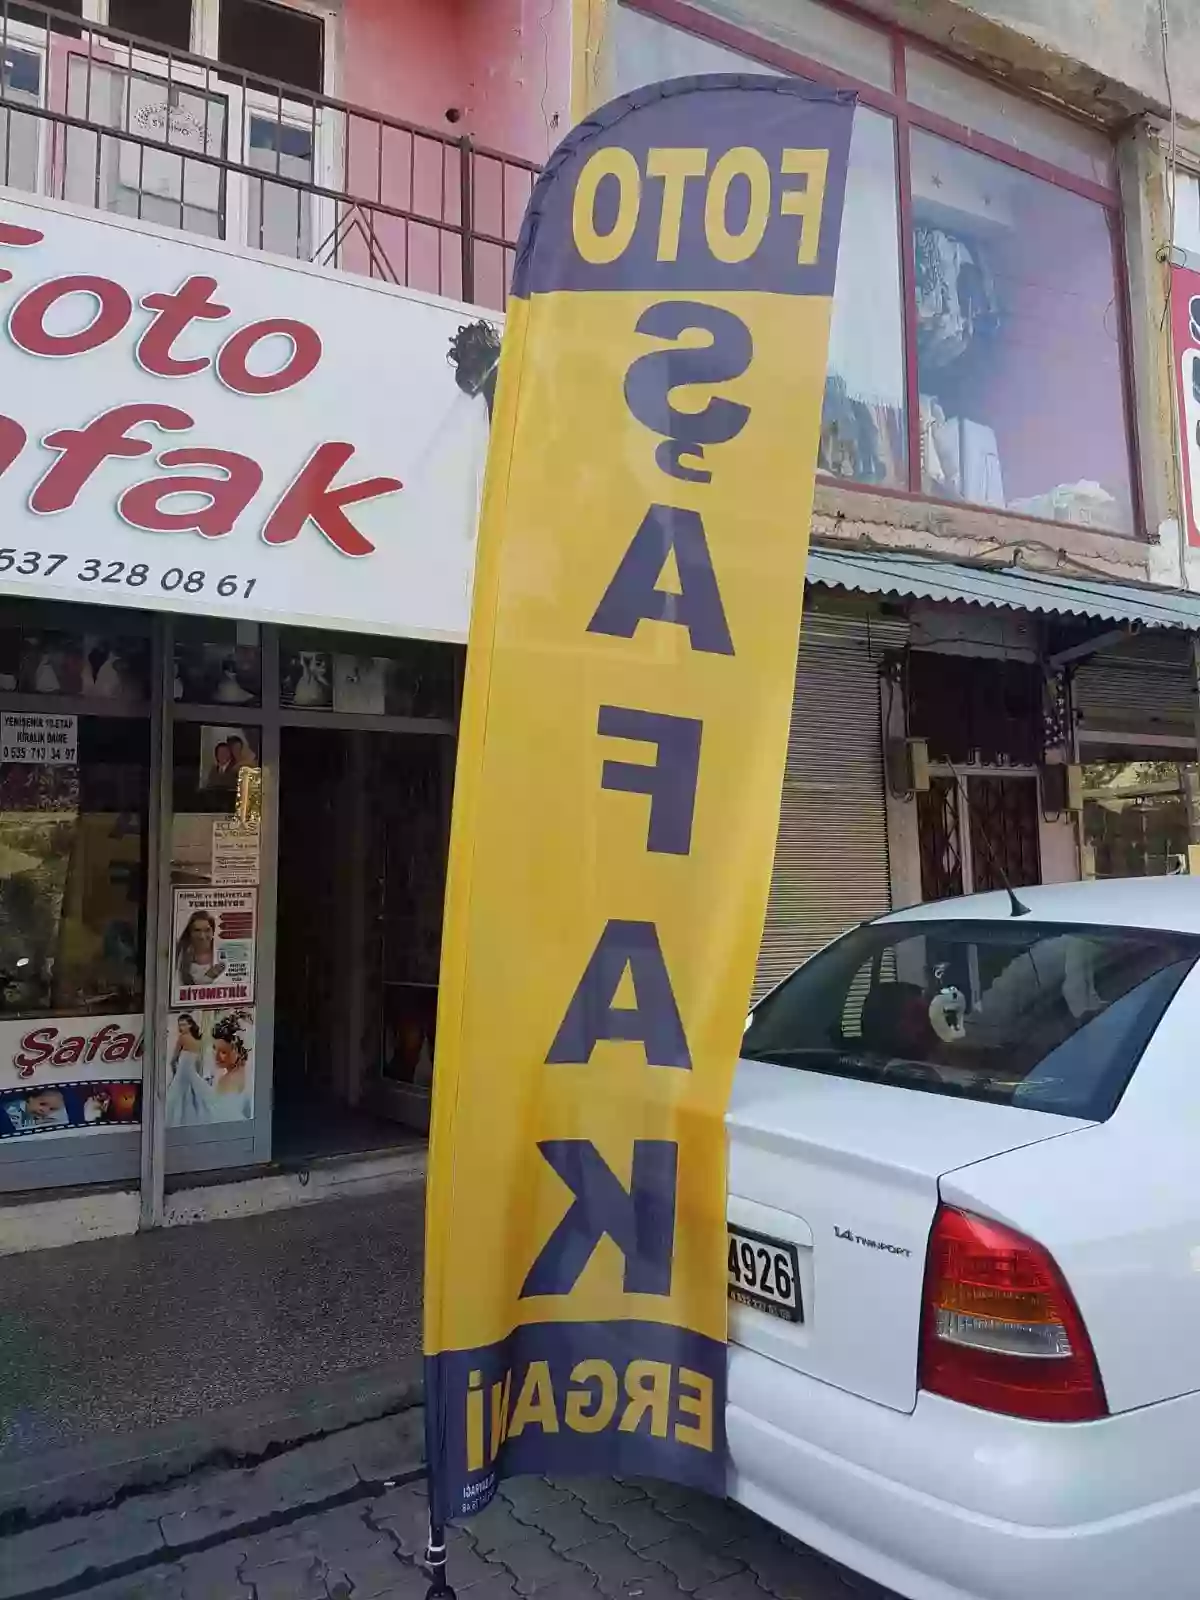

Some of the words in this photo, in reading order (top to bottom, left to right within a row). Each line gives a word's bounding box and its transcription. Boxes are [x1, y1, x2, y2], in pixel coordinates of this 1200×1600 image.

[0, 222, 324, 396] oto
[0, 548, 68, 577] 537
[77, 560, 148, 587] 328
[161, 567, 205, 593] 08
[216, 574, 257, 599] 61
[179, 984, 248, 1001] BİYOMETRİK
